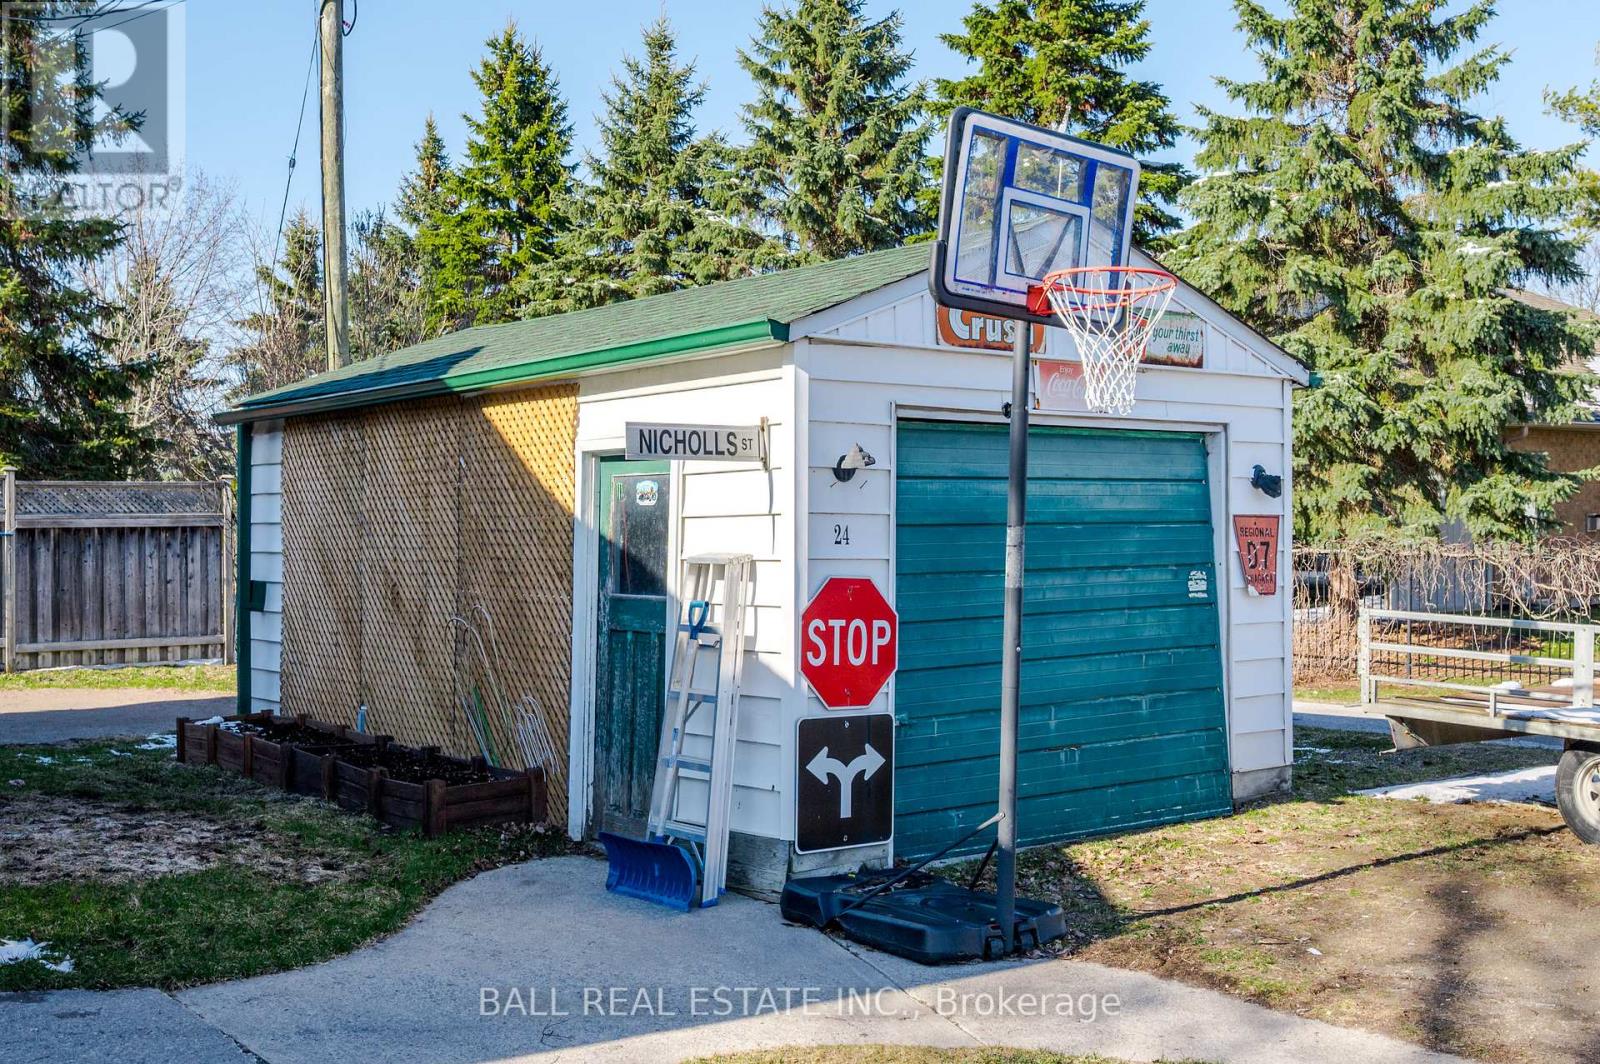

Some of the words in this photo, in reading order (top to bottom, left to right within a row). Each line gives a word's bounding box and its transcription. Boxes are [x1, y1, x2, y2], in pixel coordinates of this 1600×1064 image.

[949, 308, 1034, 344] Crus
[1153, 327, 1174, 342] your
[1175, 327, 1199, 342] thirst
[1167, 342, 1190, 356] away
[639, 428, 738, 456] NICHOLLS
[741, 438, 753, 451] ST
[834, 524, 850, 545] 24
[1240, 527, 1275, 538] REGIONAL
[806, 618, 892, 667] STOP
